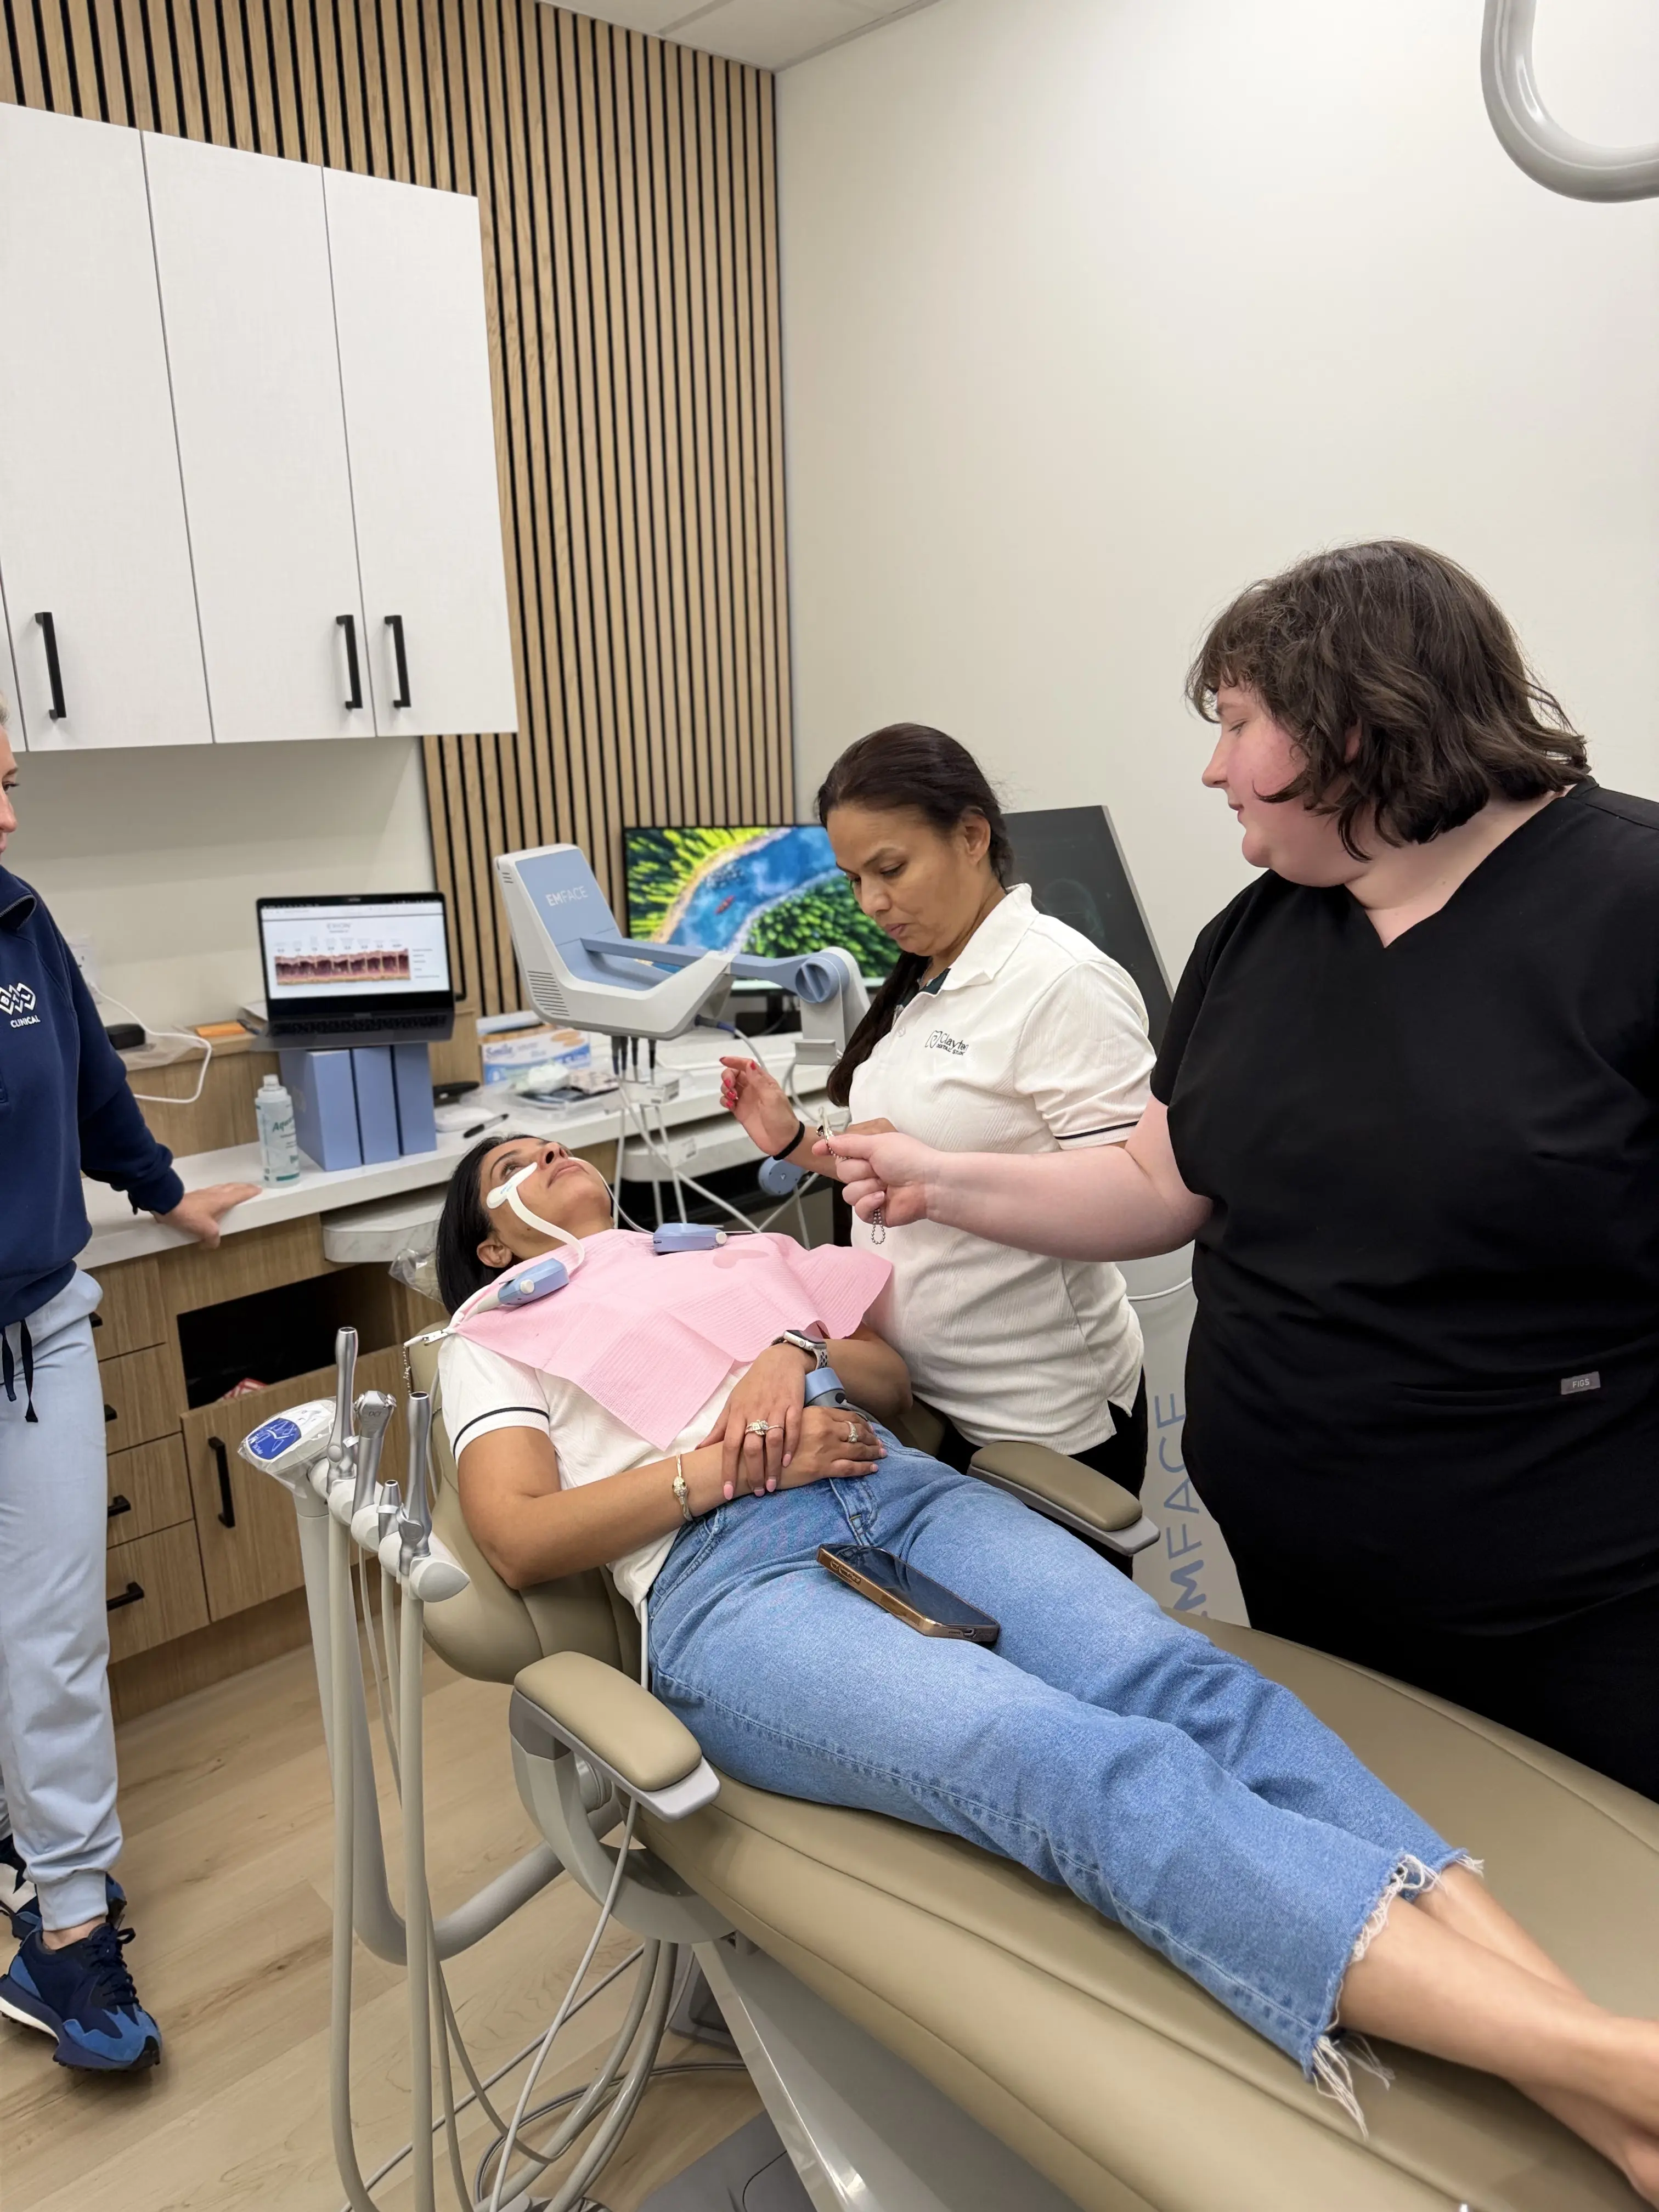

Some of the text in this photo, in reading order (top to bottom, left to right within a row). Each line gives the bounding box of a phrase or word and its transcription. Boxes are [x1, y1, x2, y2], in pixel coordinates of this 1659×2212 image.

[546, 885, 588, 906] EMFACE
[10, 1014, 41, 1029] CLINICAL
[1572, 1378, 1590, 1388] FIGS
[1155, 1393, 1208, 1618] MFACE
